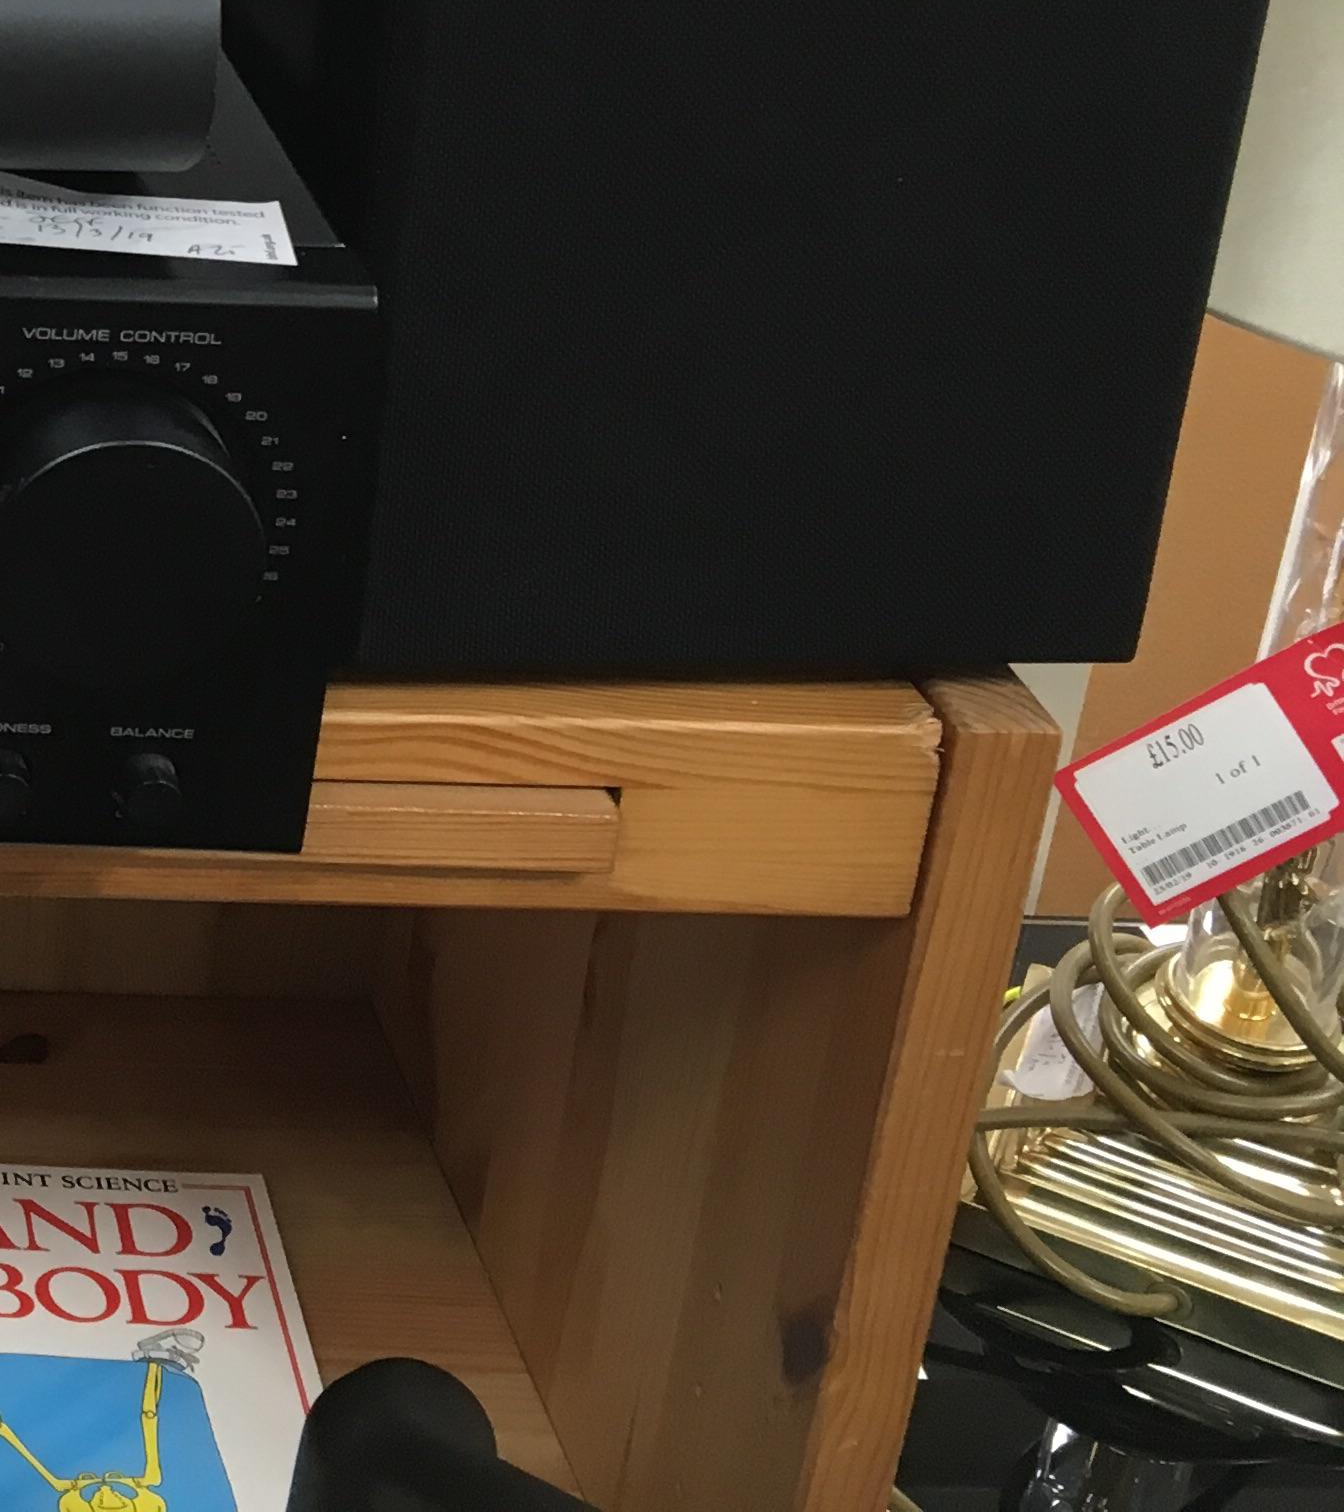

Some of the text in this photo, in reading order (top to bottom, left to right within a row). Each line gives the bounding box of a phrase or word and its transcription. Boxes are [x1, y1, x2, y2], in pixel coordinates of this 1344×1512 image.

[81, 208, 151, 220] working
[137, 203, 207, 216] function
[212, 208, 265, 219] tested
[22, 327, 222, 345] VOLUME CONTROL
[110, 726, 196, 740] BALANCE
[1146, 723, 1205, 770] £15.00
[1229, 761, 1250, 779] of
[1121, 826, 1150, 845] Light
[1128, 823, 1188, 855] Table Lamp
[62, 1174, 179, 1194] SCIENCE
